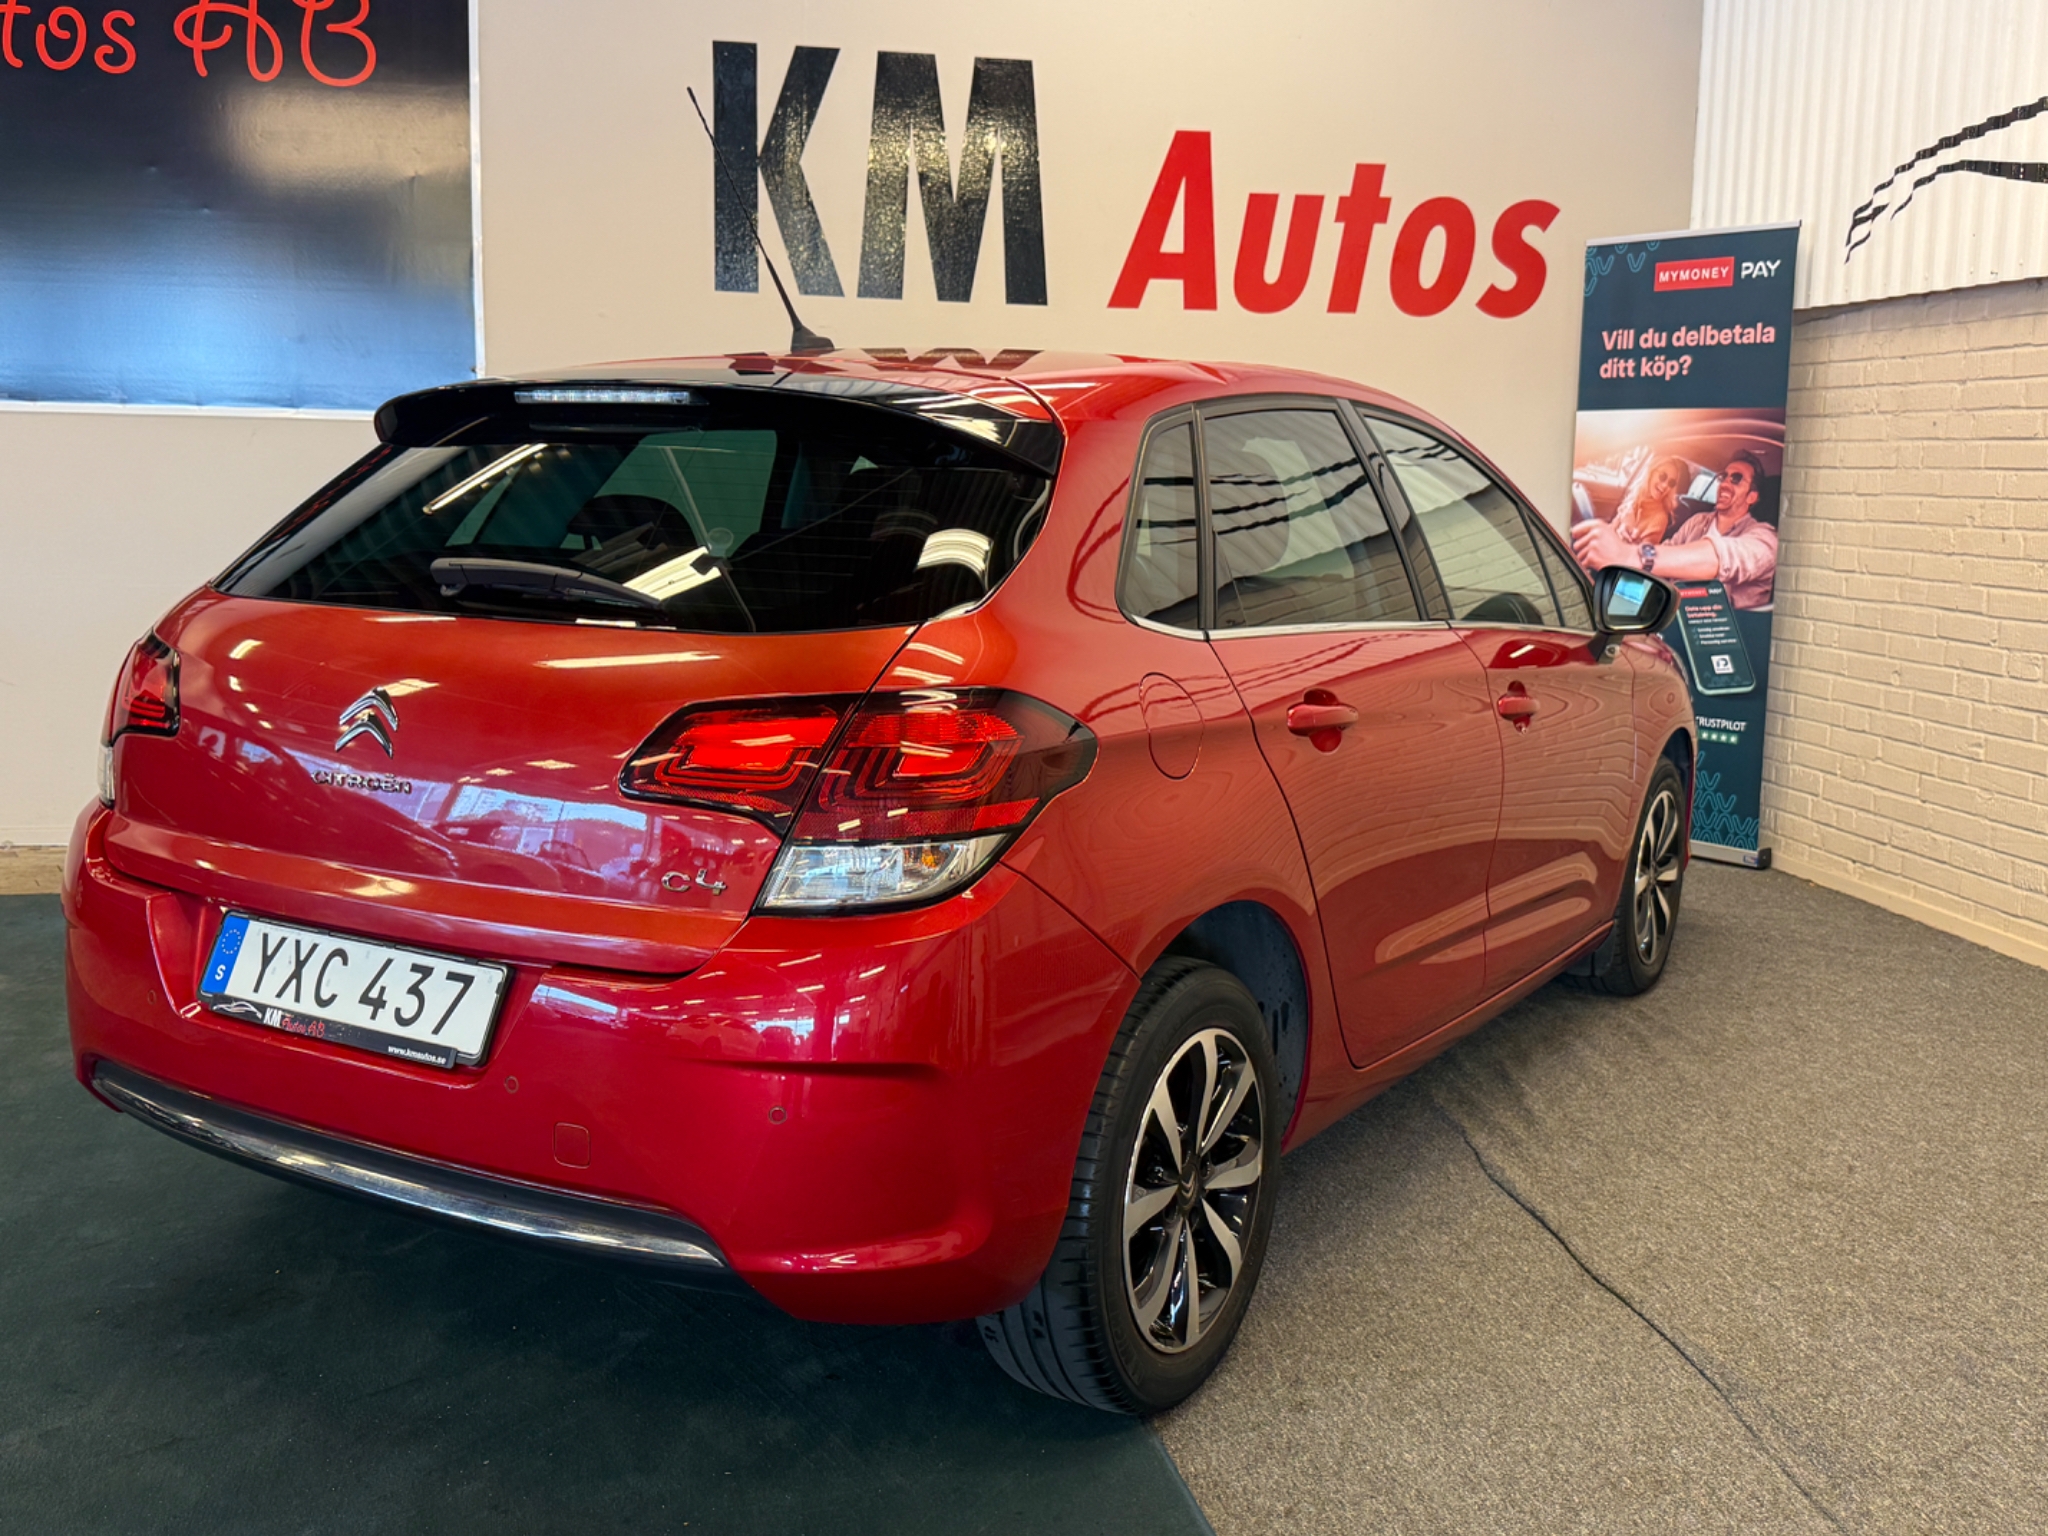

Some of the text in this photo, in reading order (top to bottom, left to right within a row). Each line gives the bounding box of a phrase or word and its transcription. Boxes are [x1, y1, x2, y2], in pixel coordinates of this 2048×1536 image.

[712, 40, 1561, 318] KM Autos
[1658, 260, 1781, 283] MYMONEY PAY
[1601, 322, 1775, 351] Vill du delbetala
[1599, 355, 1692, 380] ditt köp?
[214, 964, 226, 981] S
[252, 932, 475, 1036] YXC 437
[263, 1006, 282, 1029] KM
